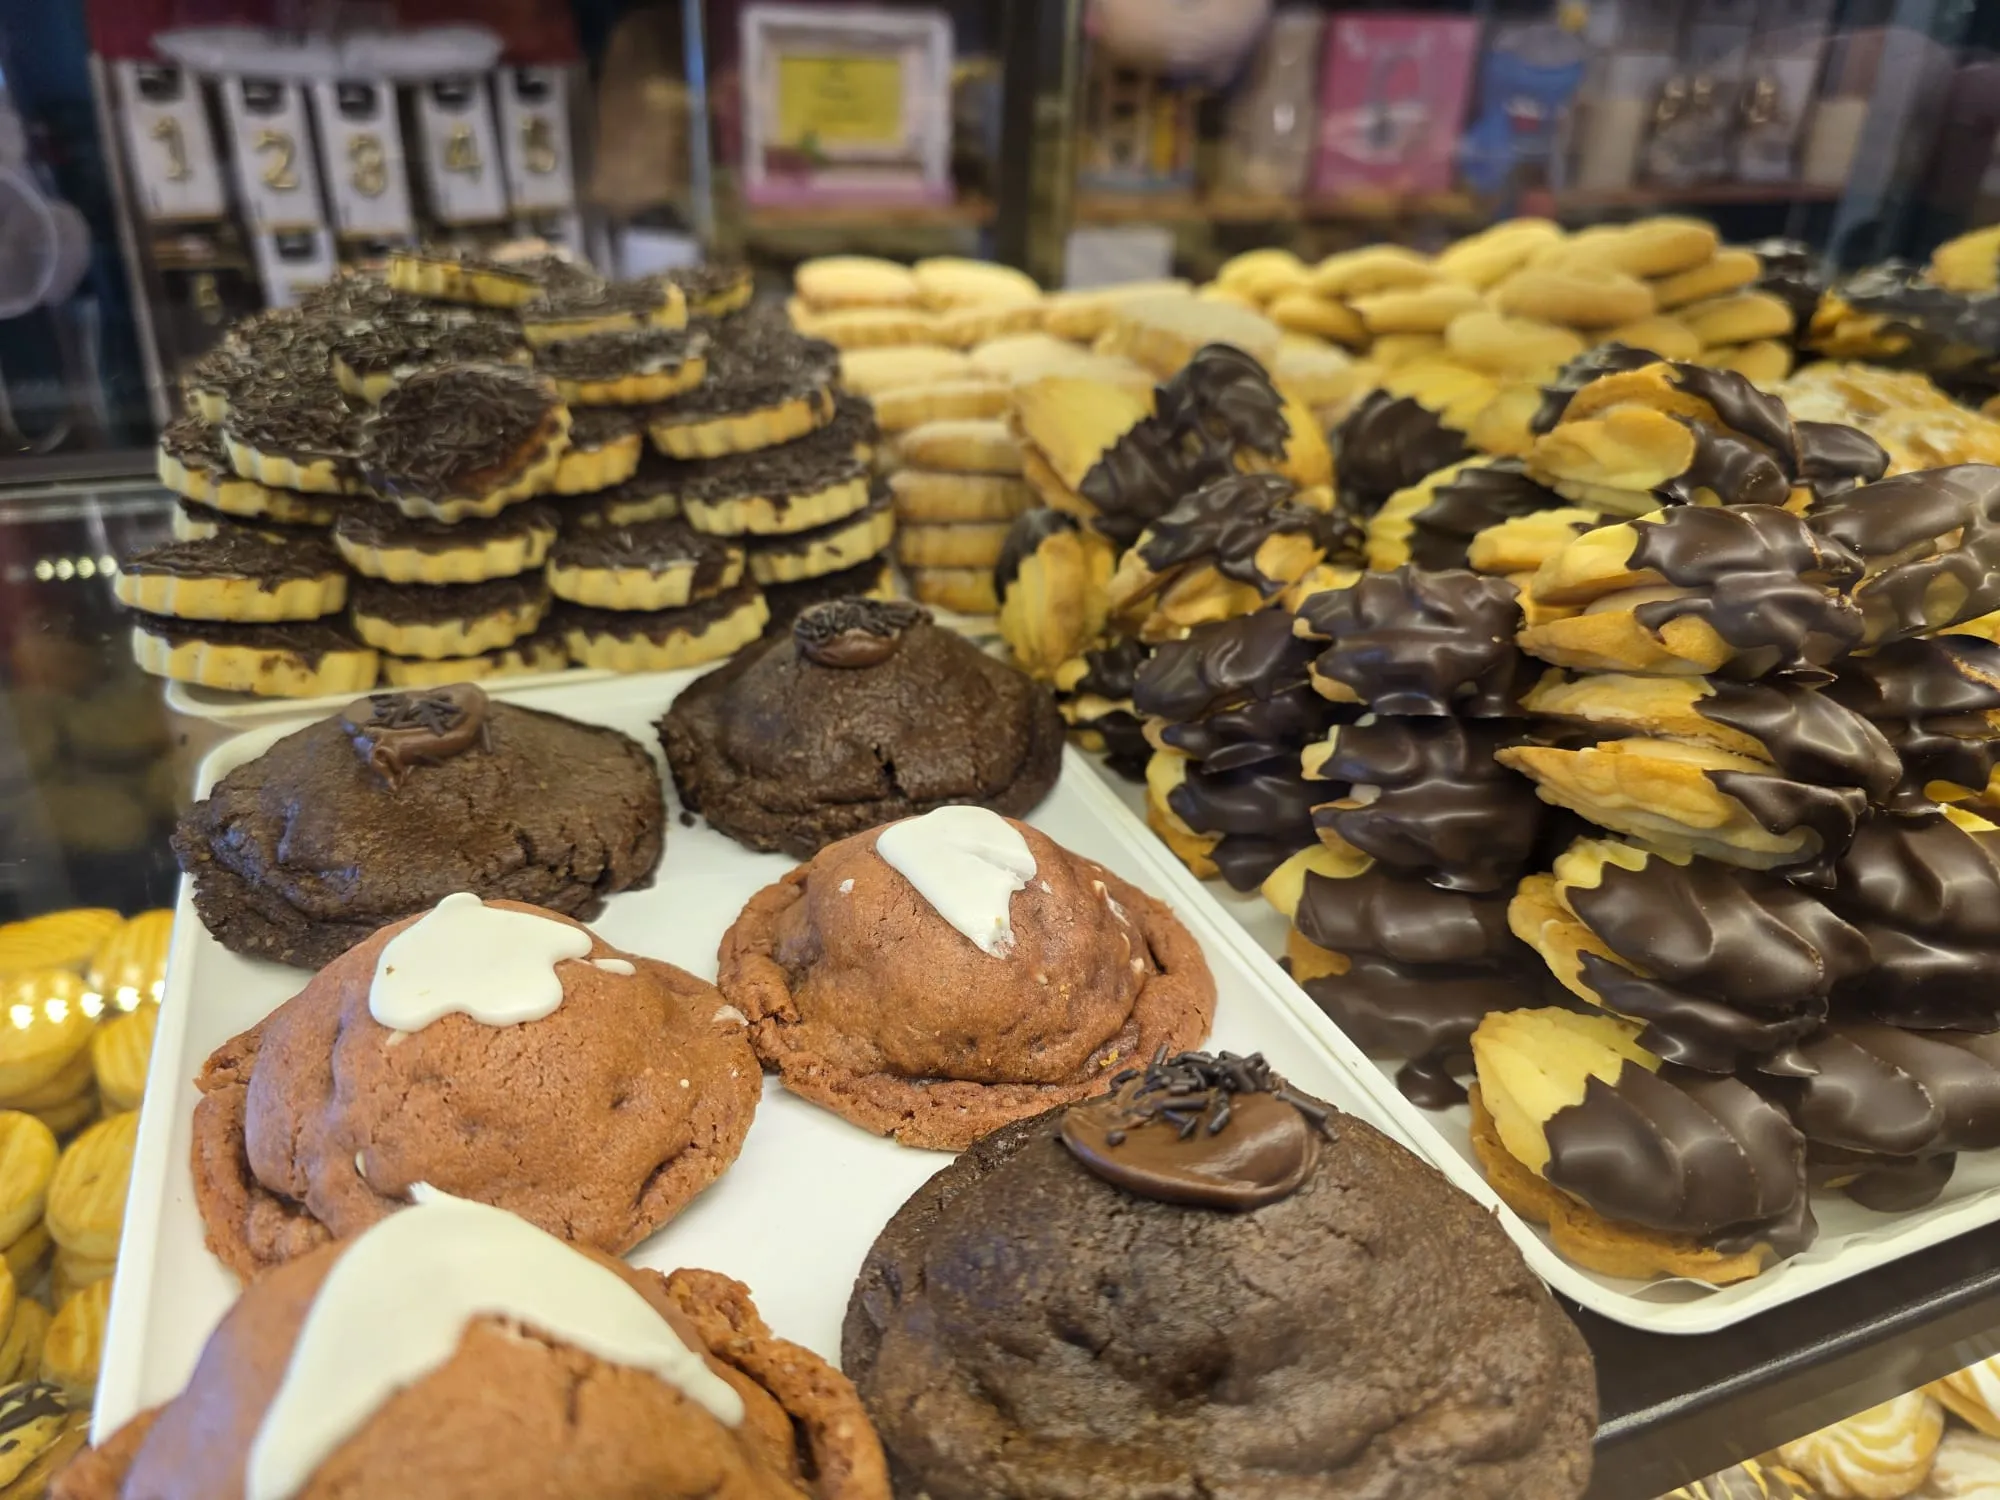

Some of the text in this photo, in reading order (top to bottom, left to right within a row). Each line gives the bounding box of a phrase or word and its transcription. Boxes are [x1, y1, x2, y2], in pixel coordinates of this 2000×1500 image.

[152, 115, 192, 182] 1
[254, 129, 300, 190] 2
[442, 121, 483, 185] 4
